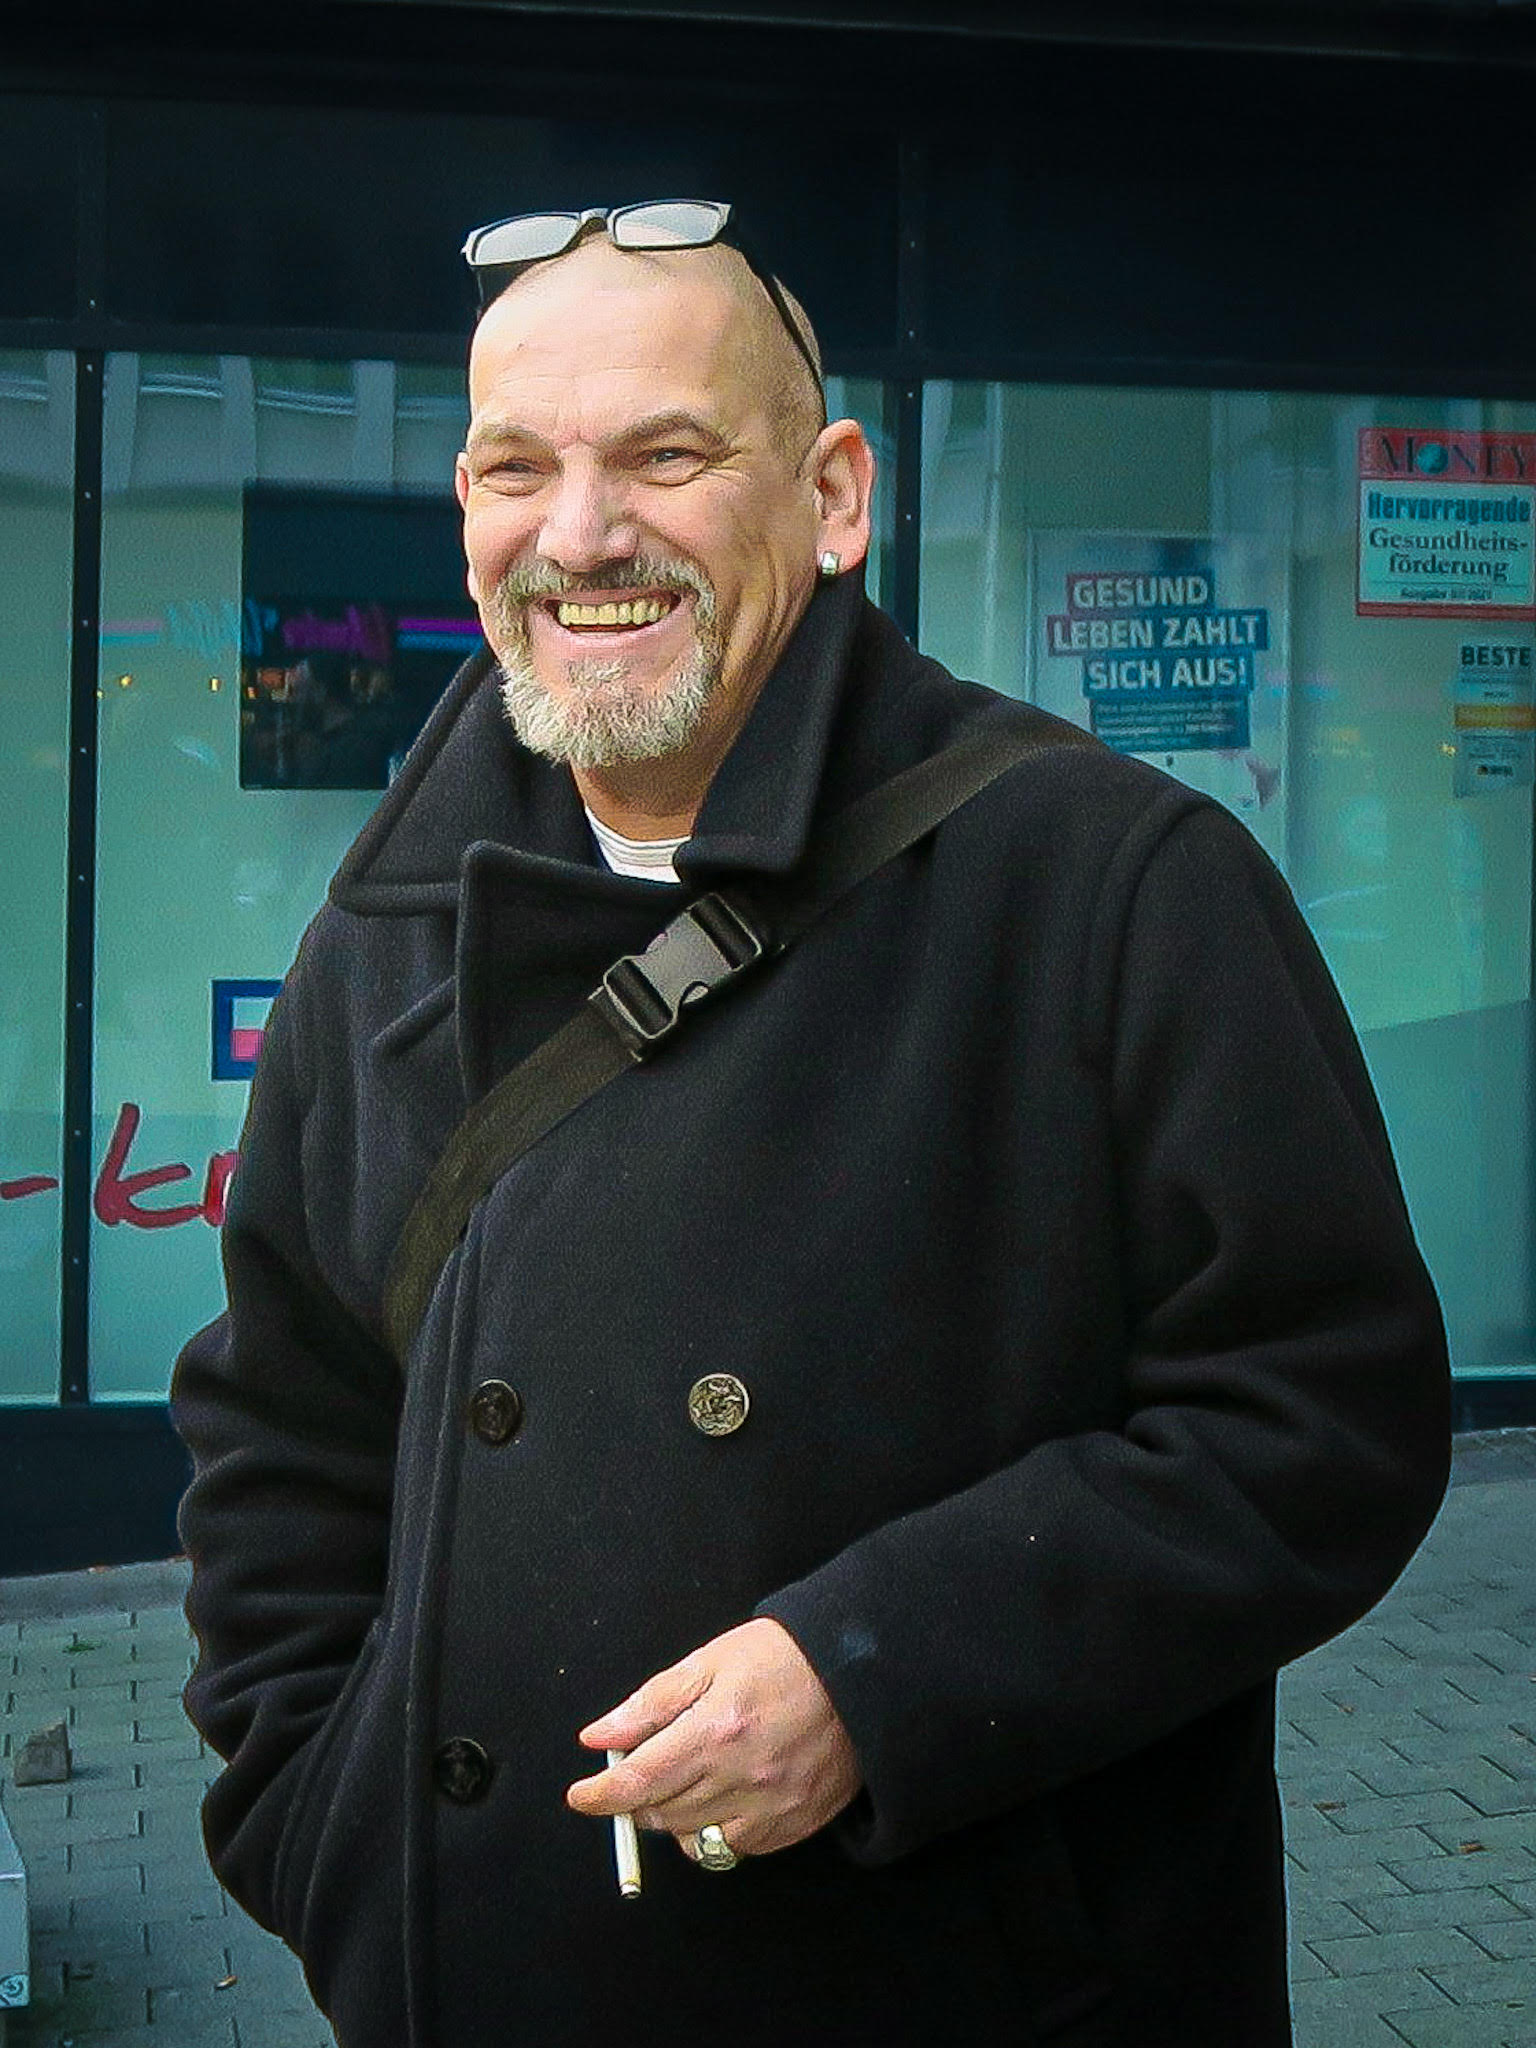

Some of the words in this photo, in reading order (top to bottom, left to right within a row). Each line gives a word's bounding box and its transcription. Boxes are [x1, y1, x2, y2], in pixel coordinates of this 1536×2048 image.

[1368, 493, 1530, 524] Hervorragende
[1369, 527, 1528, 552] Gesundheits-
[1390, 553, 1508, 583] förderung
[1073, 576, 1208, 609] GESUND
[1054, 619, 1153, 650] LEBEN
[1163, 615, 1257, 647] ZAHLT
[1461, 645, 1531, 667] BESTE
[1089, 660, 1161, 690] SICH
[1172, 658, 1246, 688] AUS!
